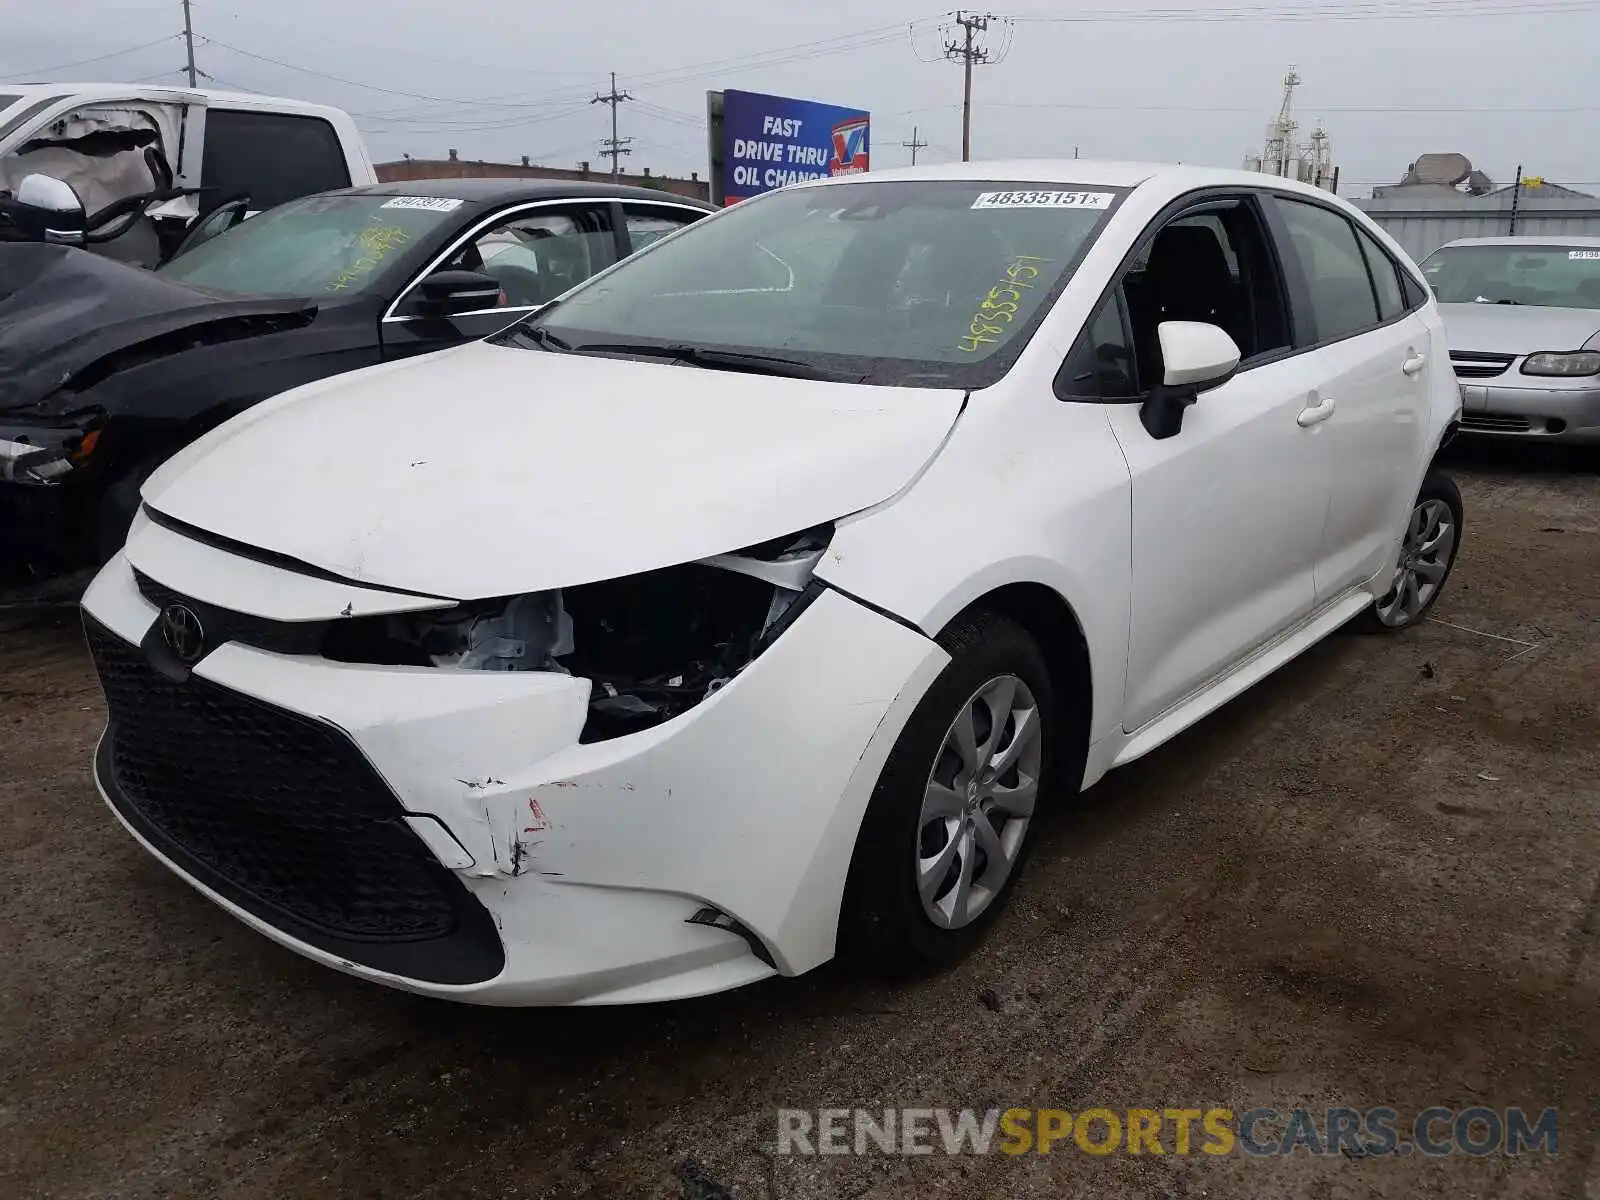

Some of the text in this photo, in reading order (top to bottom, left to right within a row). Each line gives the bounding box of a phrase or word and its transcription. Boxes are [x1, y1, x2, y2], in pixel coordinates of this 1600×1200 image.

[763, 116, 802, 138] FAST
[733, 139, 828, 166] DRIVE THRU
[733, 166, 760, 186] OIL
